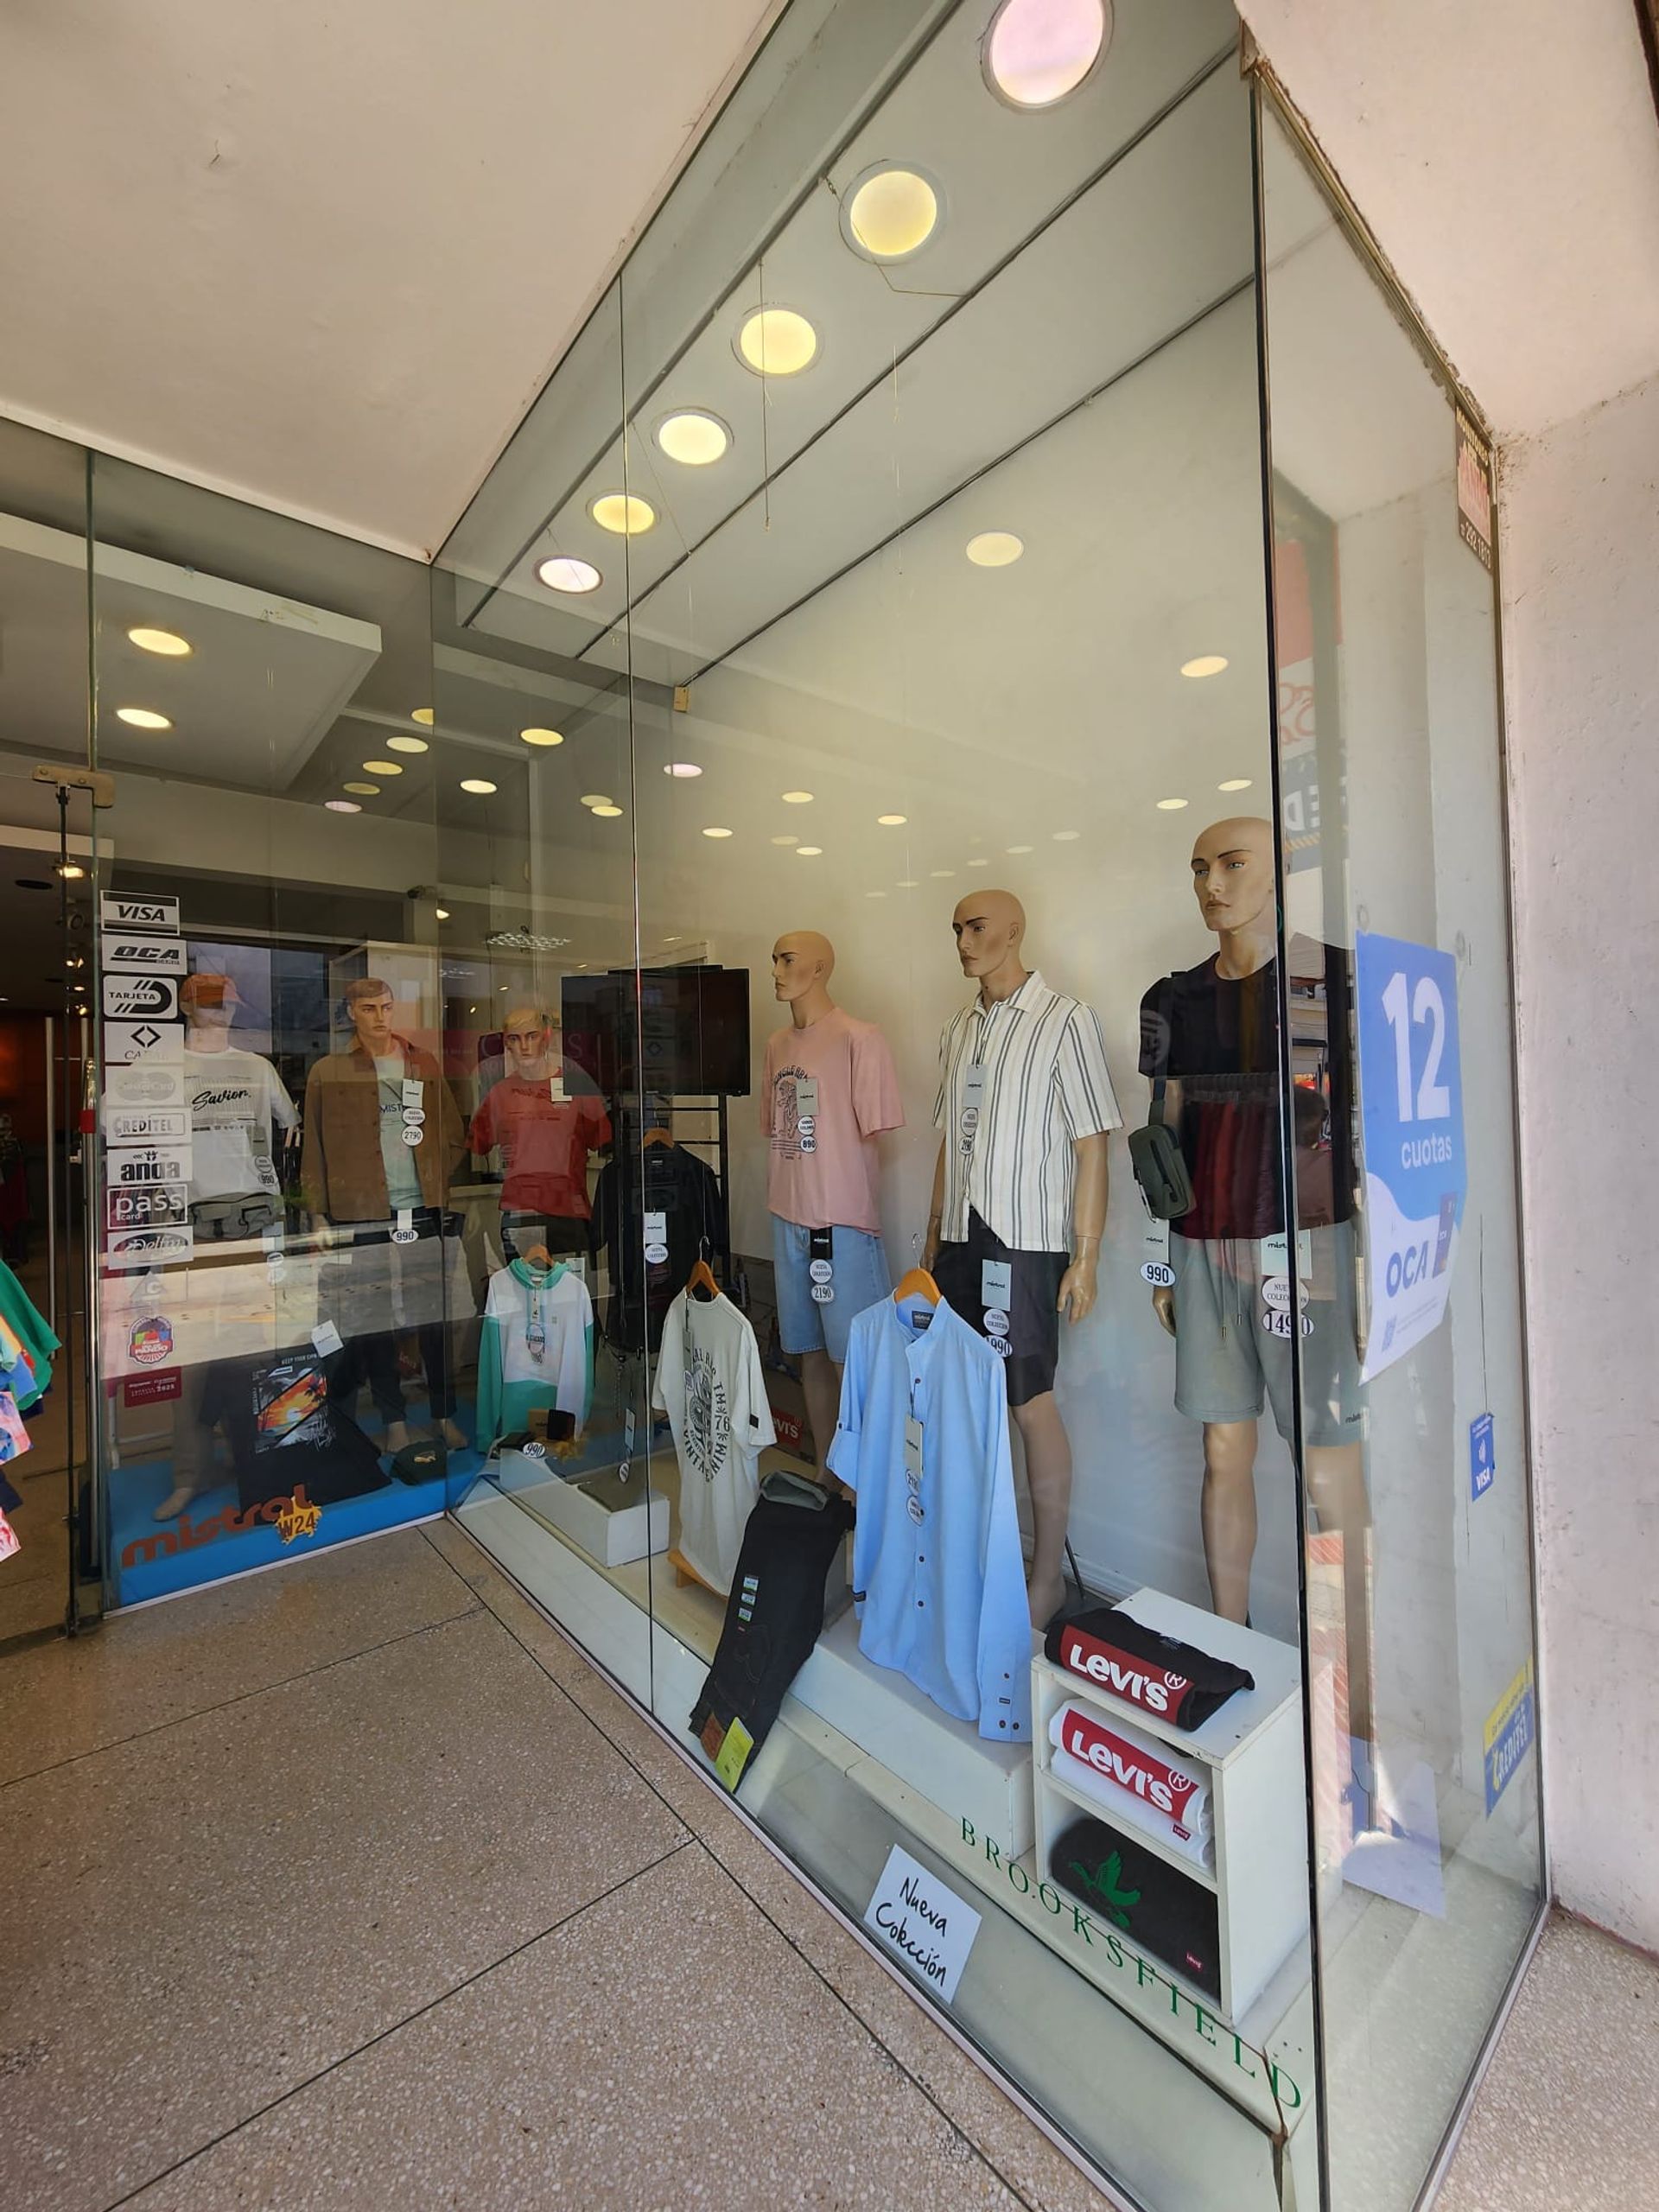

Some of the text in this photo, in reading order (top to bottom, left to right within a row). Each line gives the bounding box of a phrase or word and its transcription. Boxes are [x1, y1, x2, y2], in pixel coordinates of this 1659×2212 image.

[118, 905, 165, 922] VISA
[114, 945, 180, 959] OCA
[1382, 972, 1451, 1122] 12
[113, 1115, 173, 1133] CREDITEL
[1402, 1134, 1452, 1169] cuotas
[121, 1161, 180, 1181] anda
[116, 1193, 182, 1221] pass
[397, 1230, 414, 1241] 990
[1147, 1265, 1169, 1284] 990
[1386, 1240, 1429, 1298] OCA
[1476, 1466, 1491, 1491] VISA
[122, 1484, 313, 1568] mistral
[279, 1511, 316, 1541] W24
[899, 1877, 947, 1937] Nueva
[875, 1902, 947, 1986] Colección
[961, 1816, 1302, 2109] BROOKSFIELD
